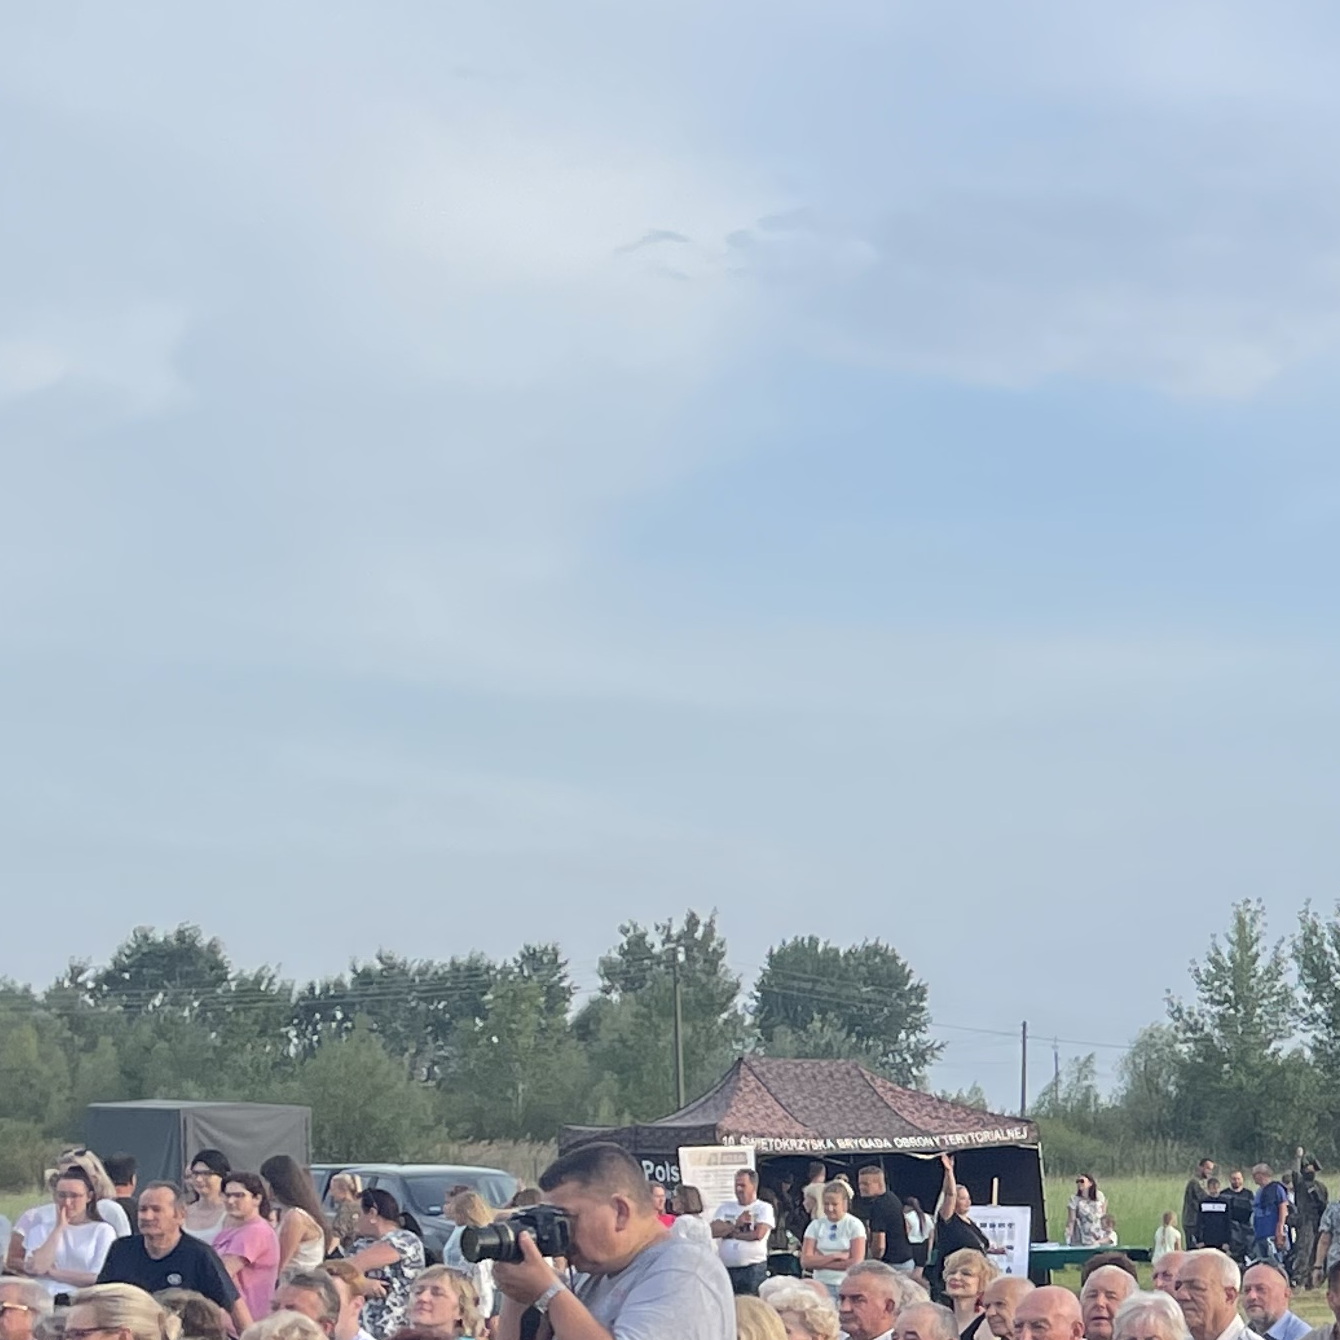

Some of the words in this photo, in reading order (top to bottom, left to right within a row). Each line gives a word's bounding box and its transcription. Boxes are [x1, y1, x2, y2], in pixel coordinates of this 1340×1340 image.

[837, 1137, 892, 1149] BRYGADA
[894, 1136, 940, 1149] OBRONY
[943, 1126, 1029, 1146] TERYTORIALNEJ
[641, 1160, 680, 1182] Pols
